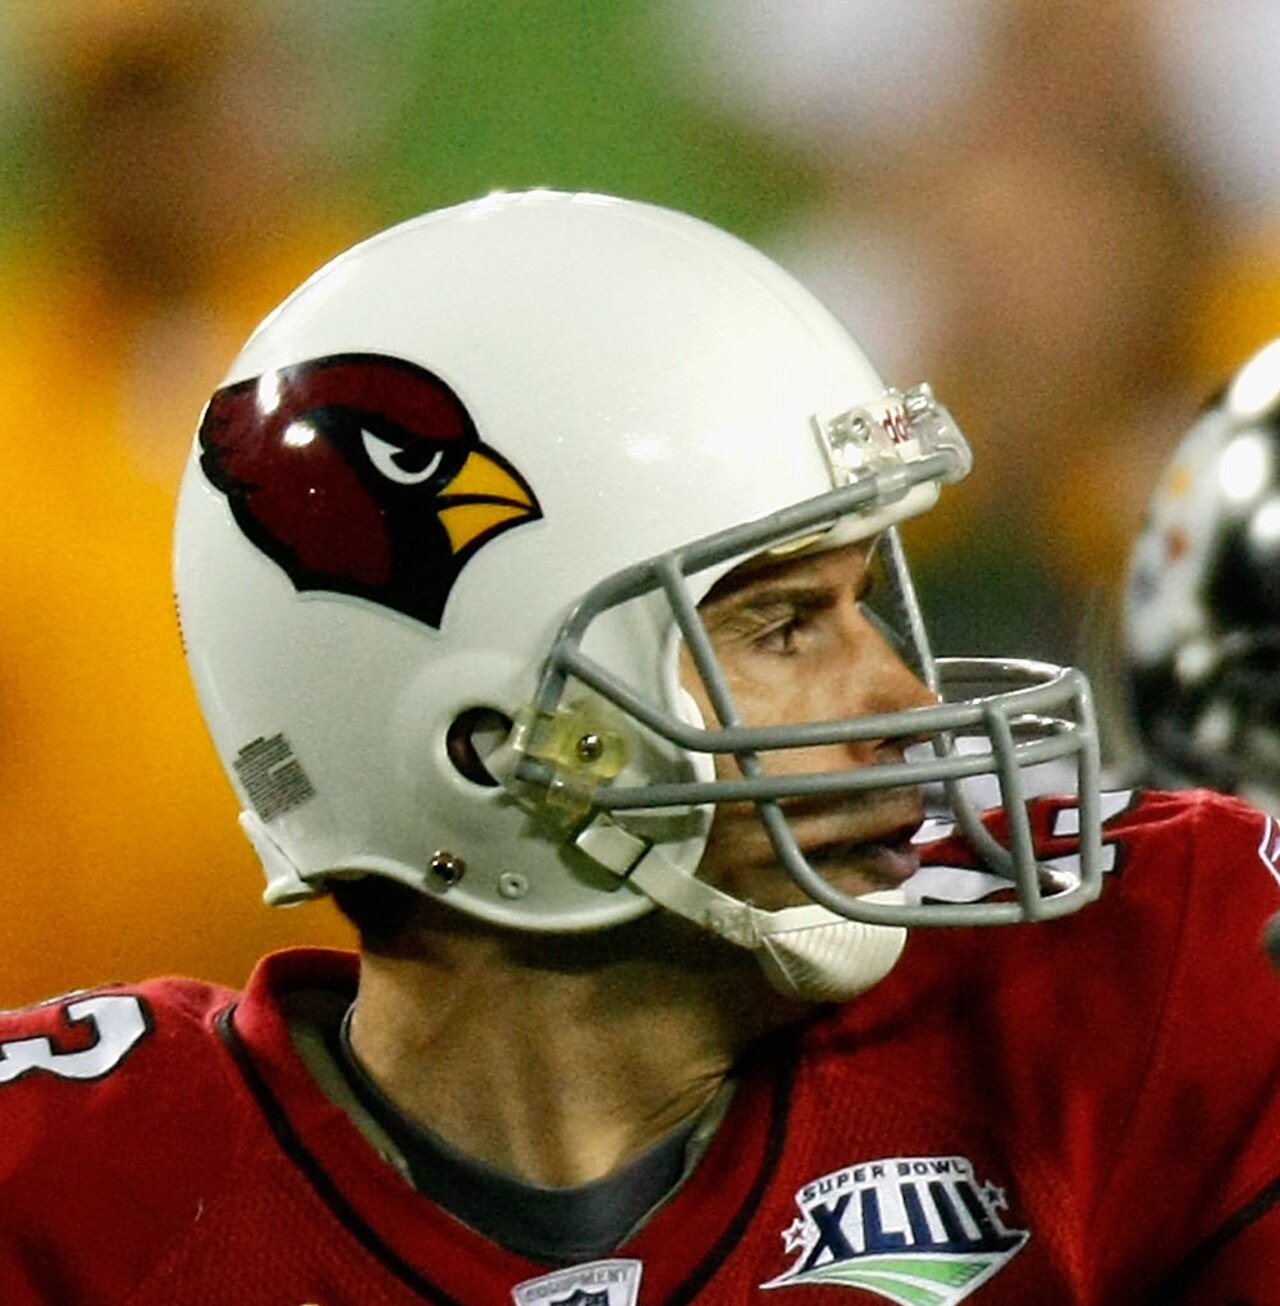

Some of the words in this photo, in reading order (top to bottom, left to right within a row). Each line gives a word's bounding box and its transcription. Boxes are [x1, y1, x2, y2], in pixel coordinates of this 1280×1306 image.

[800, 1164, 887, 1204] SUPER
[896, 1157, 970, 1180] BOWL
[798, 1180, 1001, 1276] XLIII
